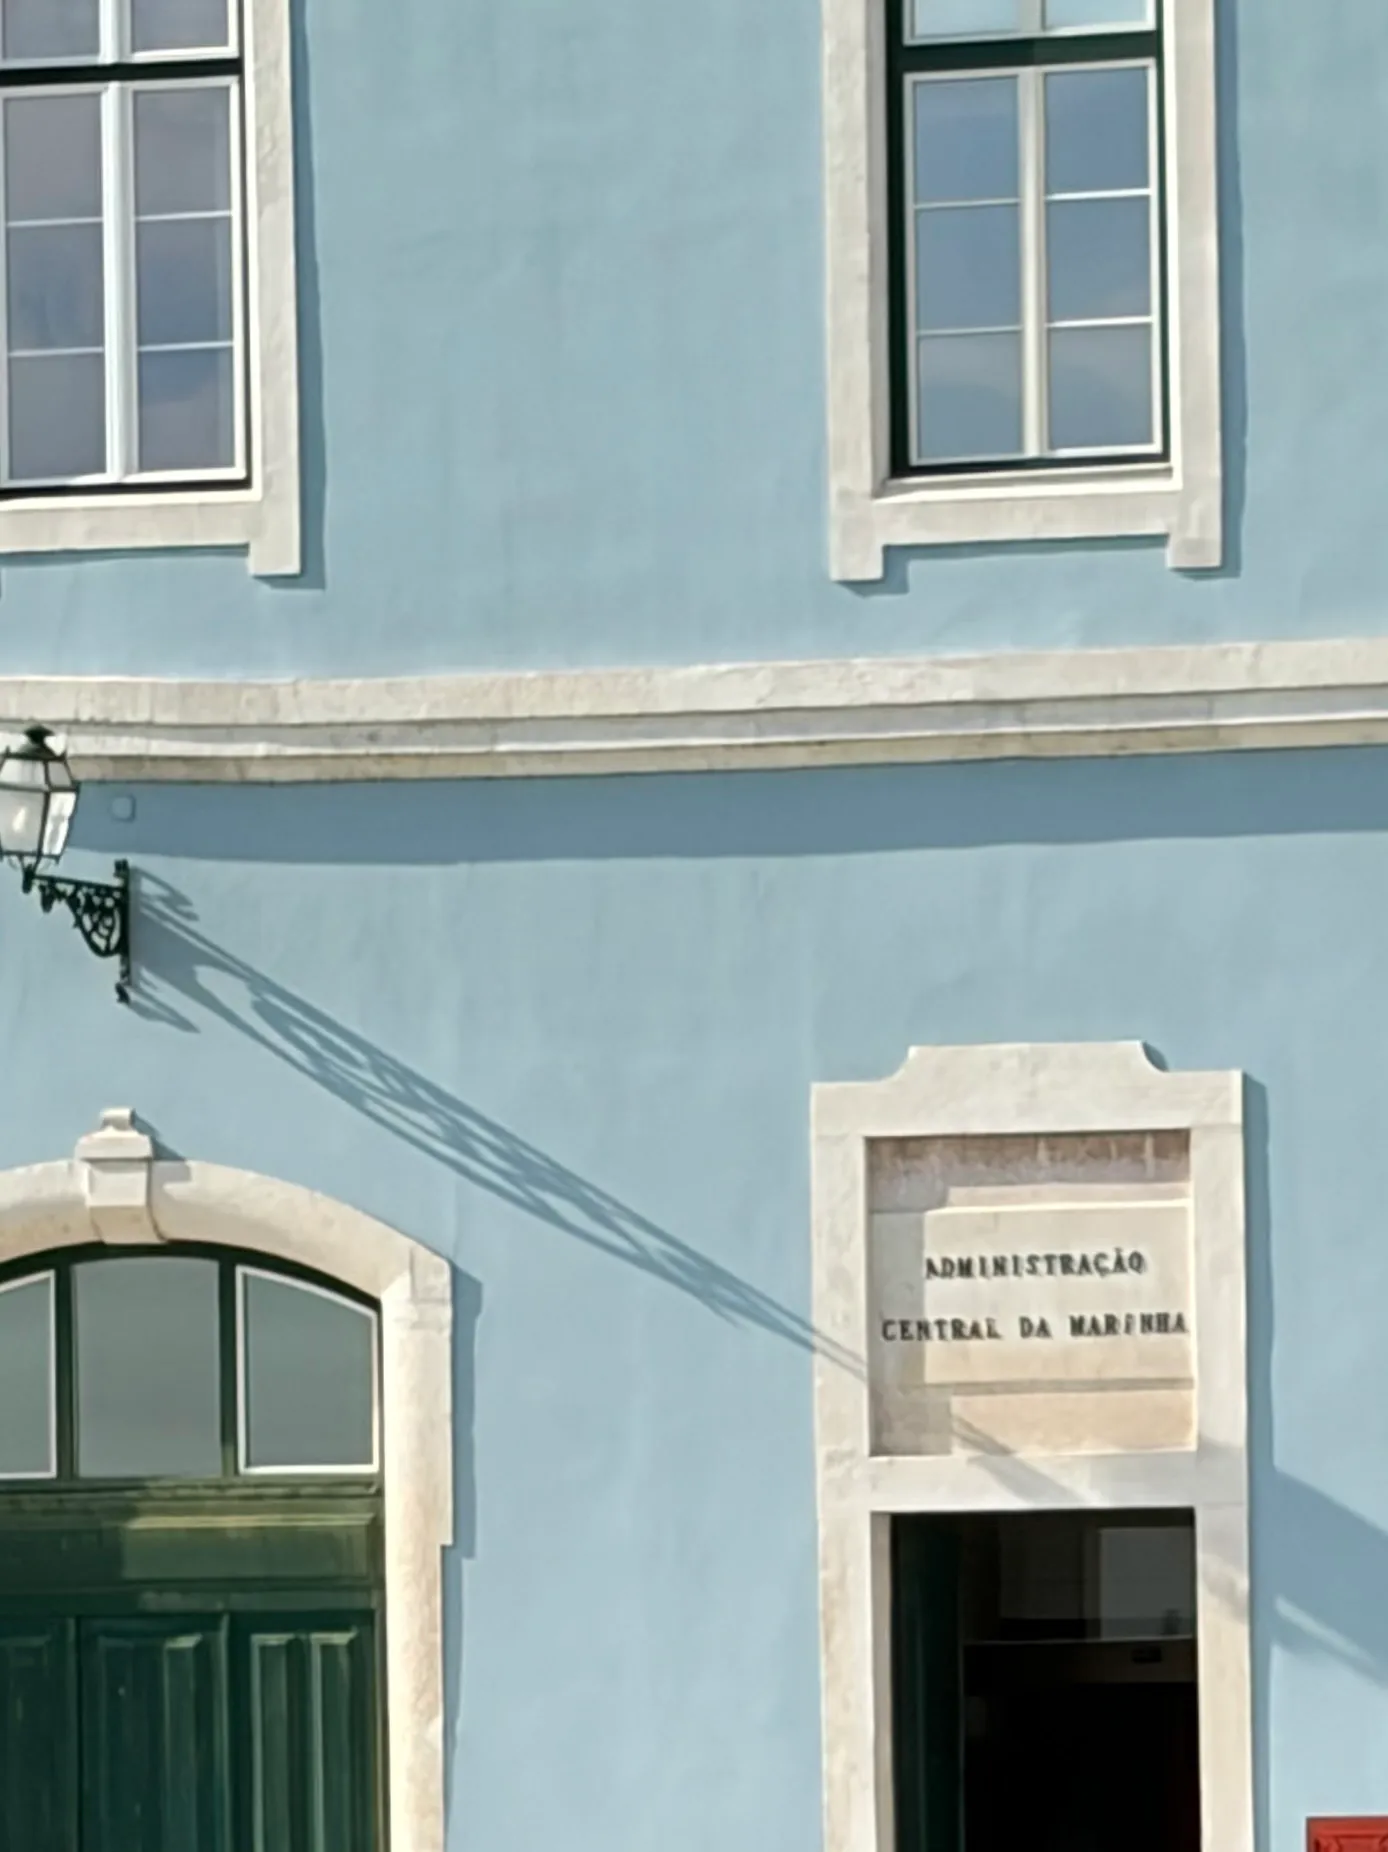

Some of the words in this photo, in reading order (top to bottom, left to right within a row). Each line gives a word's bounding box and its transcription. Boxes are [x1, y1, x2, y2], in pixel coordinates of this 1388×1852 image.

[925, 1248, 1147, 1280] ADMINISTRAÇÃO
[881, 1317, 1003, 1342] CENTRAL
[1019, 1316, 1053, 1339] DA
[1069, 1312, 1188, 1338] MARINHA
